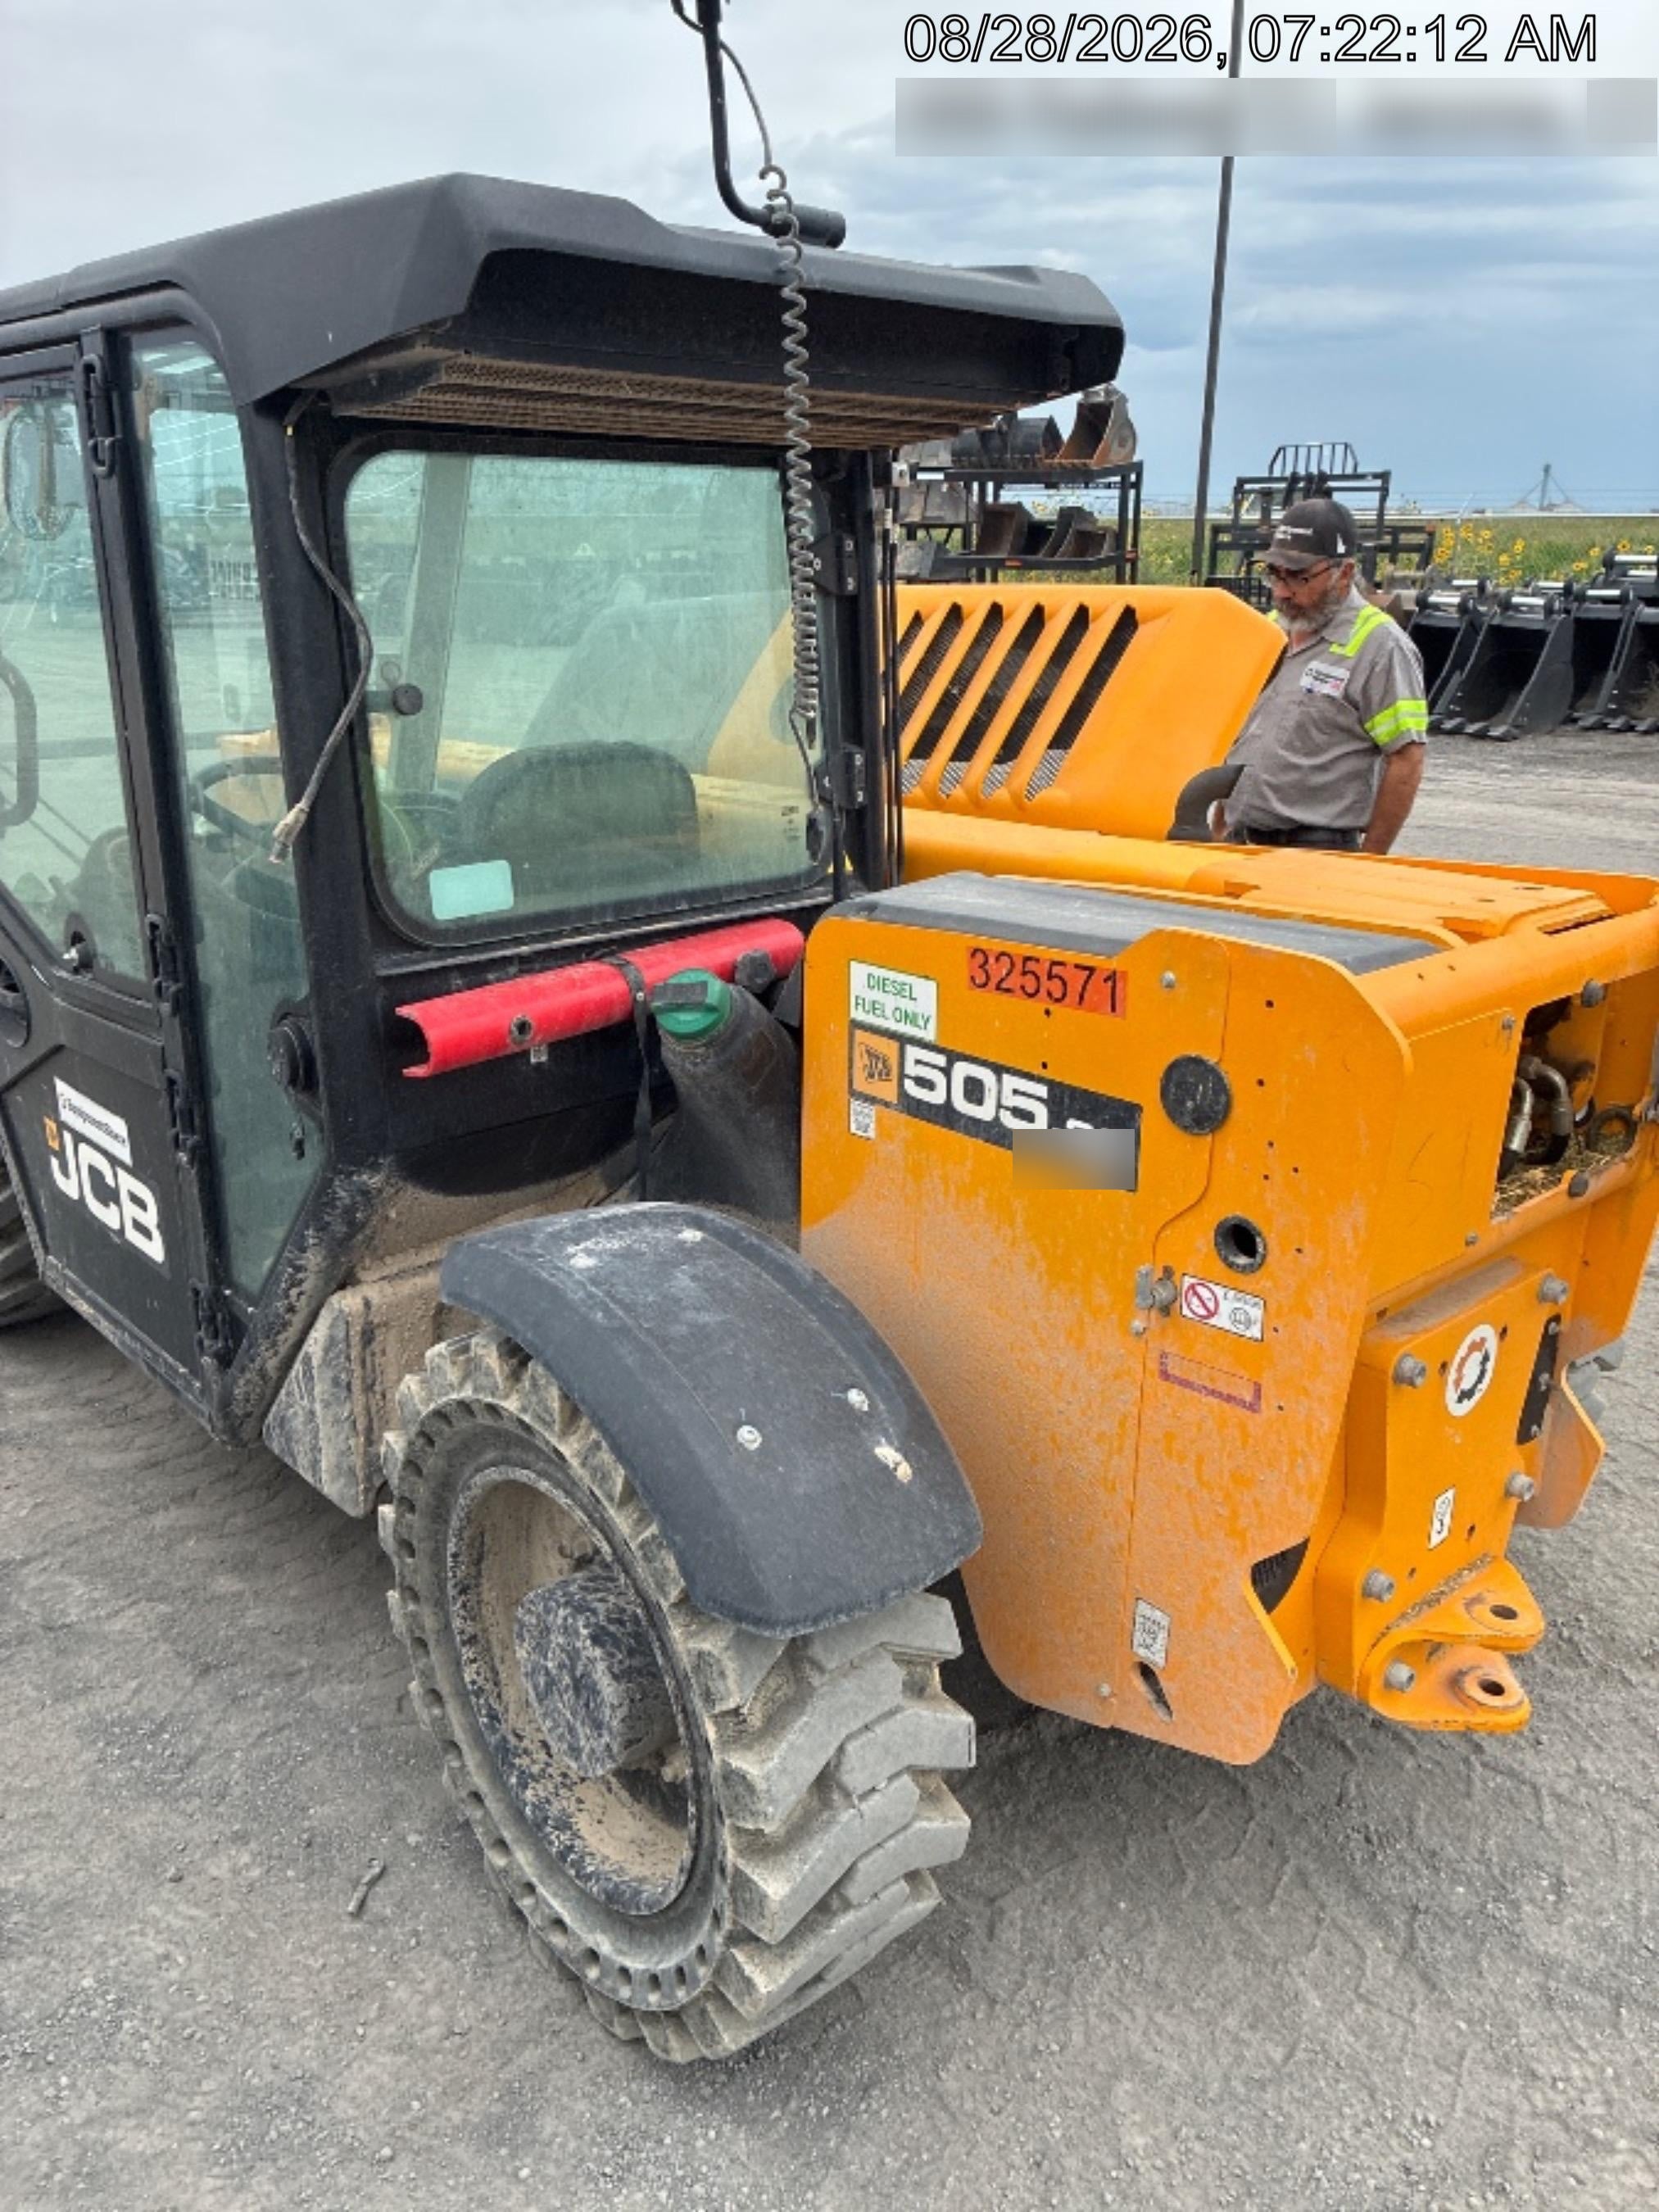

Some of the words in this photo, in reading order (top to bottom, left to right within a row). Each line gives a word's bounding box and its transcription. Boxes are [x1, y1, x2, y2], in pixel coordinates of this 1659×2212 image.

[866, 972, 918, 1002] DIESEL
[970, 947, 1117, 1013] 325571
[854, 995, 891, 1021] FUEL
[891, 1005, 932, 1031] ONLY
[50, 1130, 165, 1264] JCB
